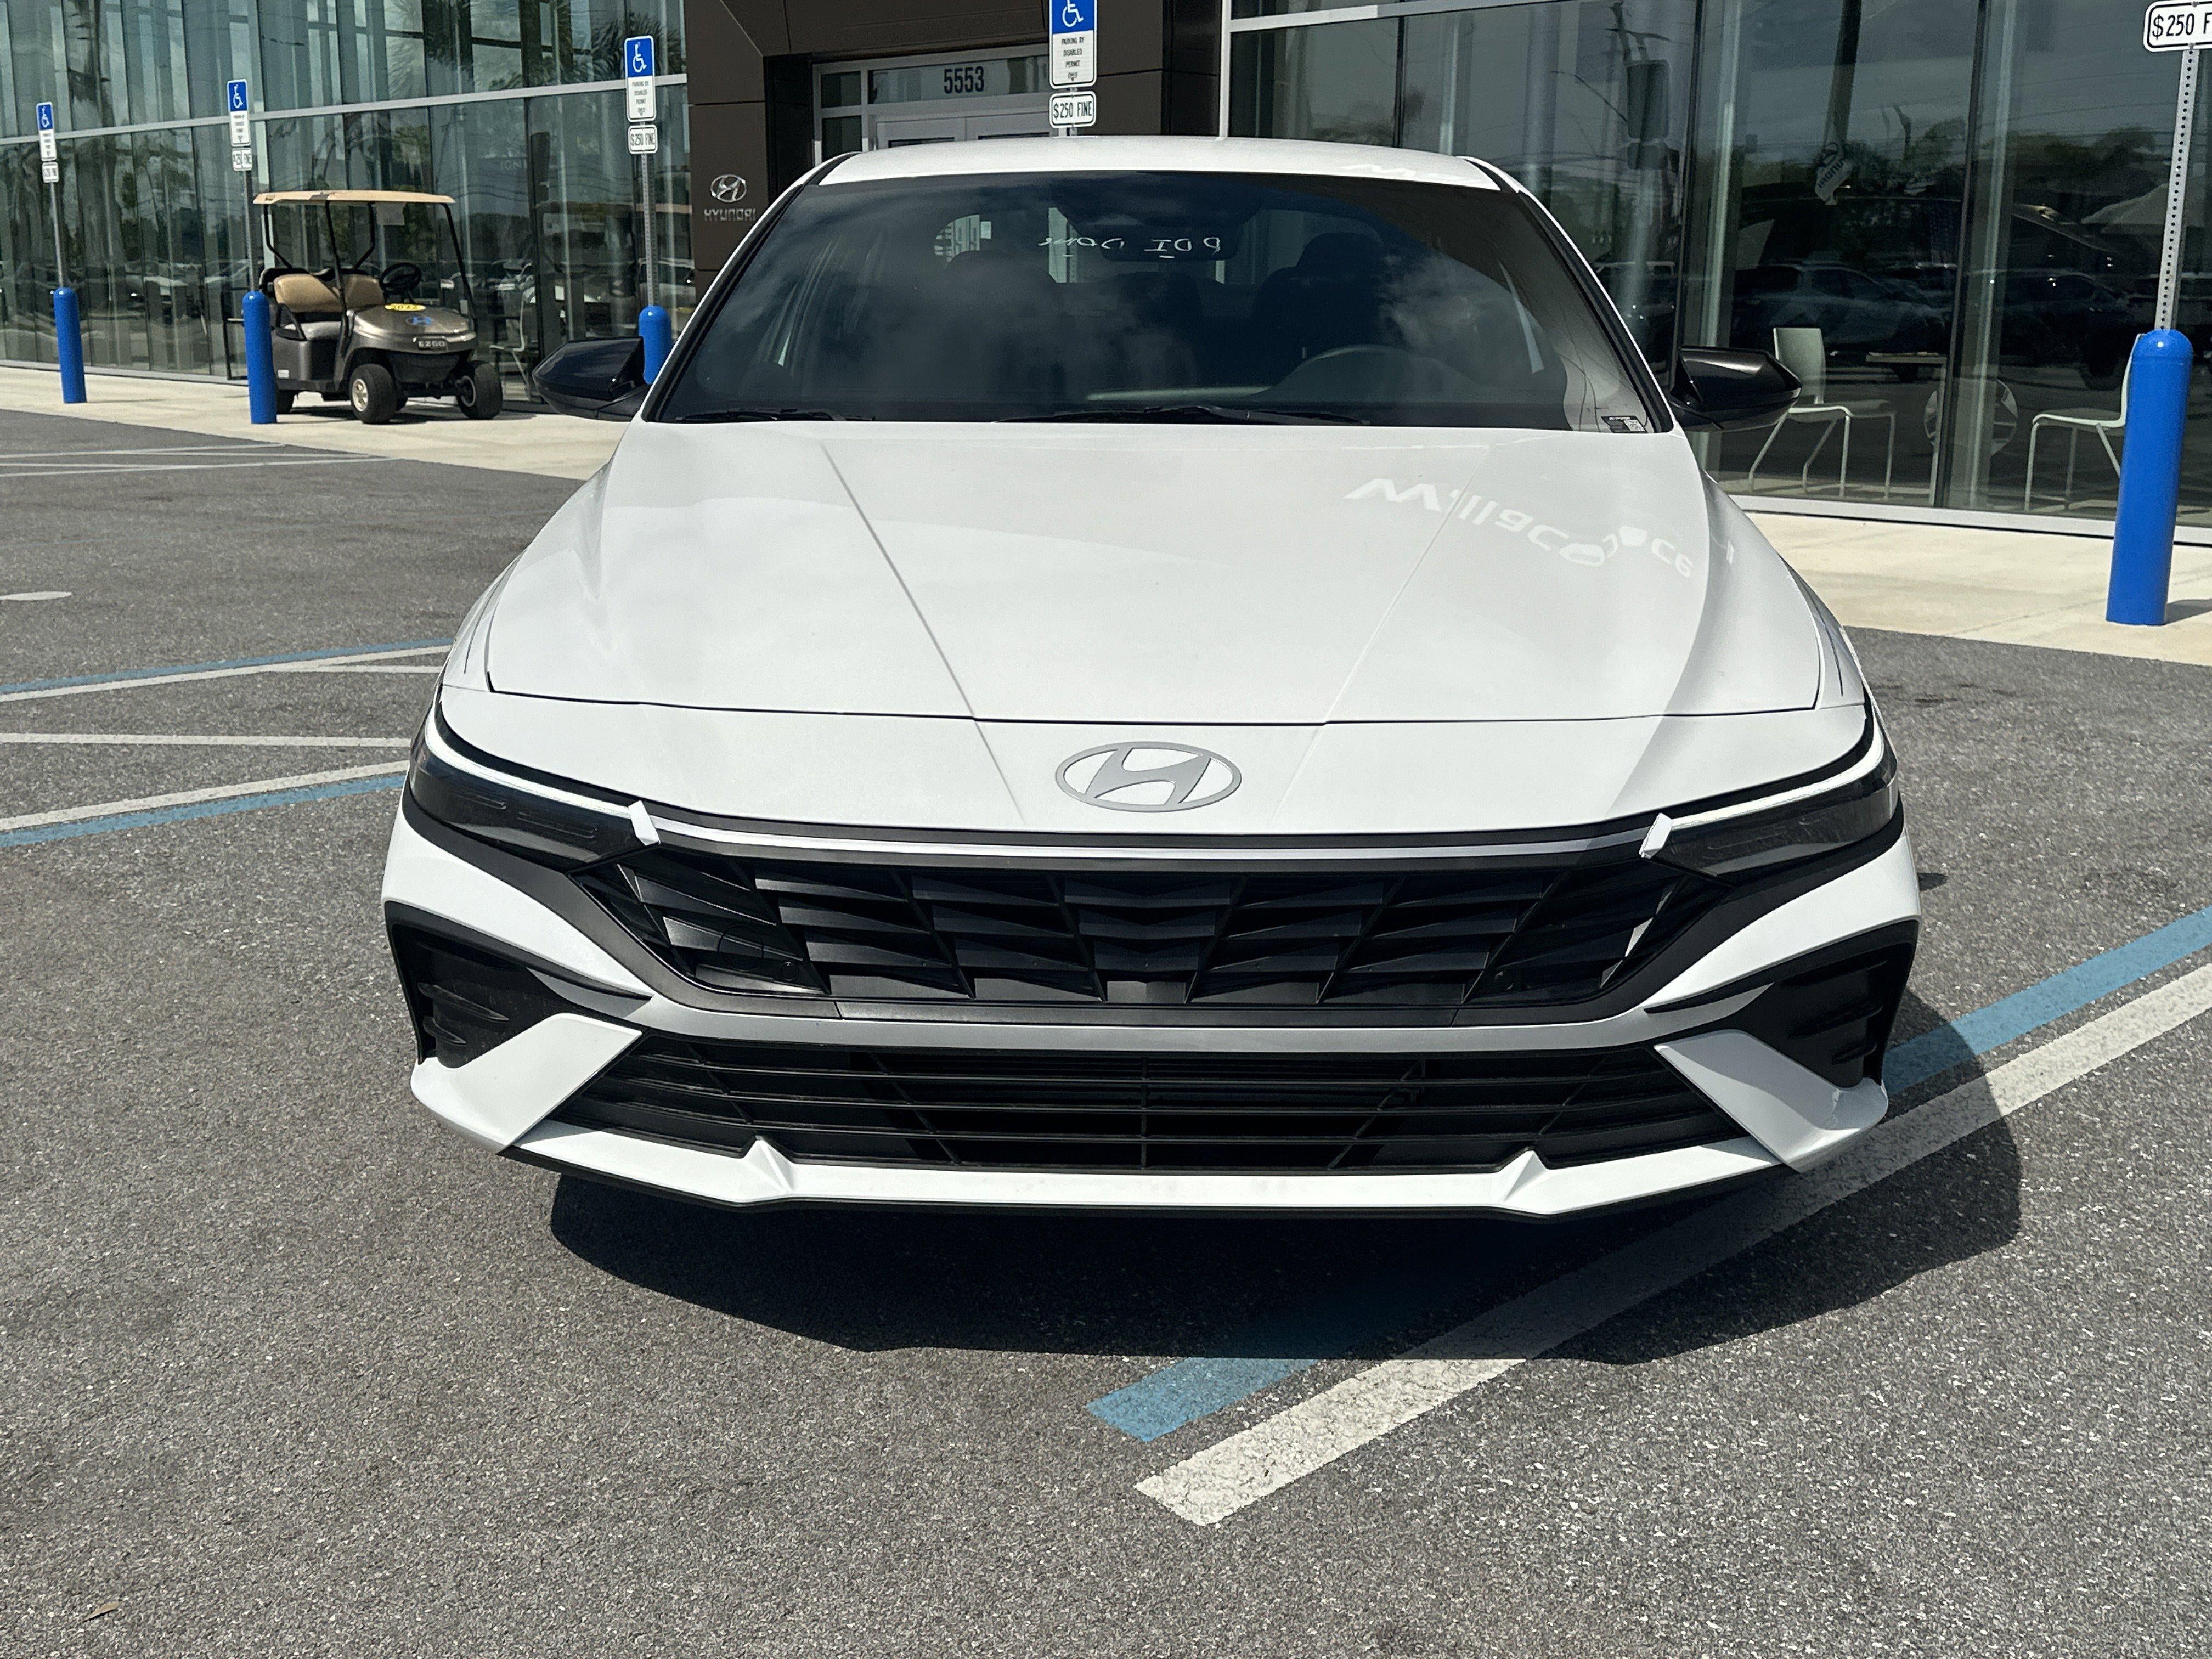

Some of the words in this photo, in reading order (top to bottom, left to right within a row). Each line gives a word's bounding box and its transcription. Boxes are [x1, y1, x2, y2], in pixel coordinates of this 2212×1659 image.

[2152, 13, 2194, 40] $250
[1063, 48, 1082, 57] DISABLED
[944, 66, 985, 94] 5553
[1053, 102, 1074, 119] $250
[1077, 101, 1092, 117] FINE
[704, 208, 756, 222] HYUNDAI
